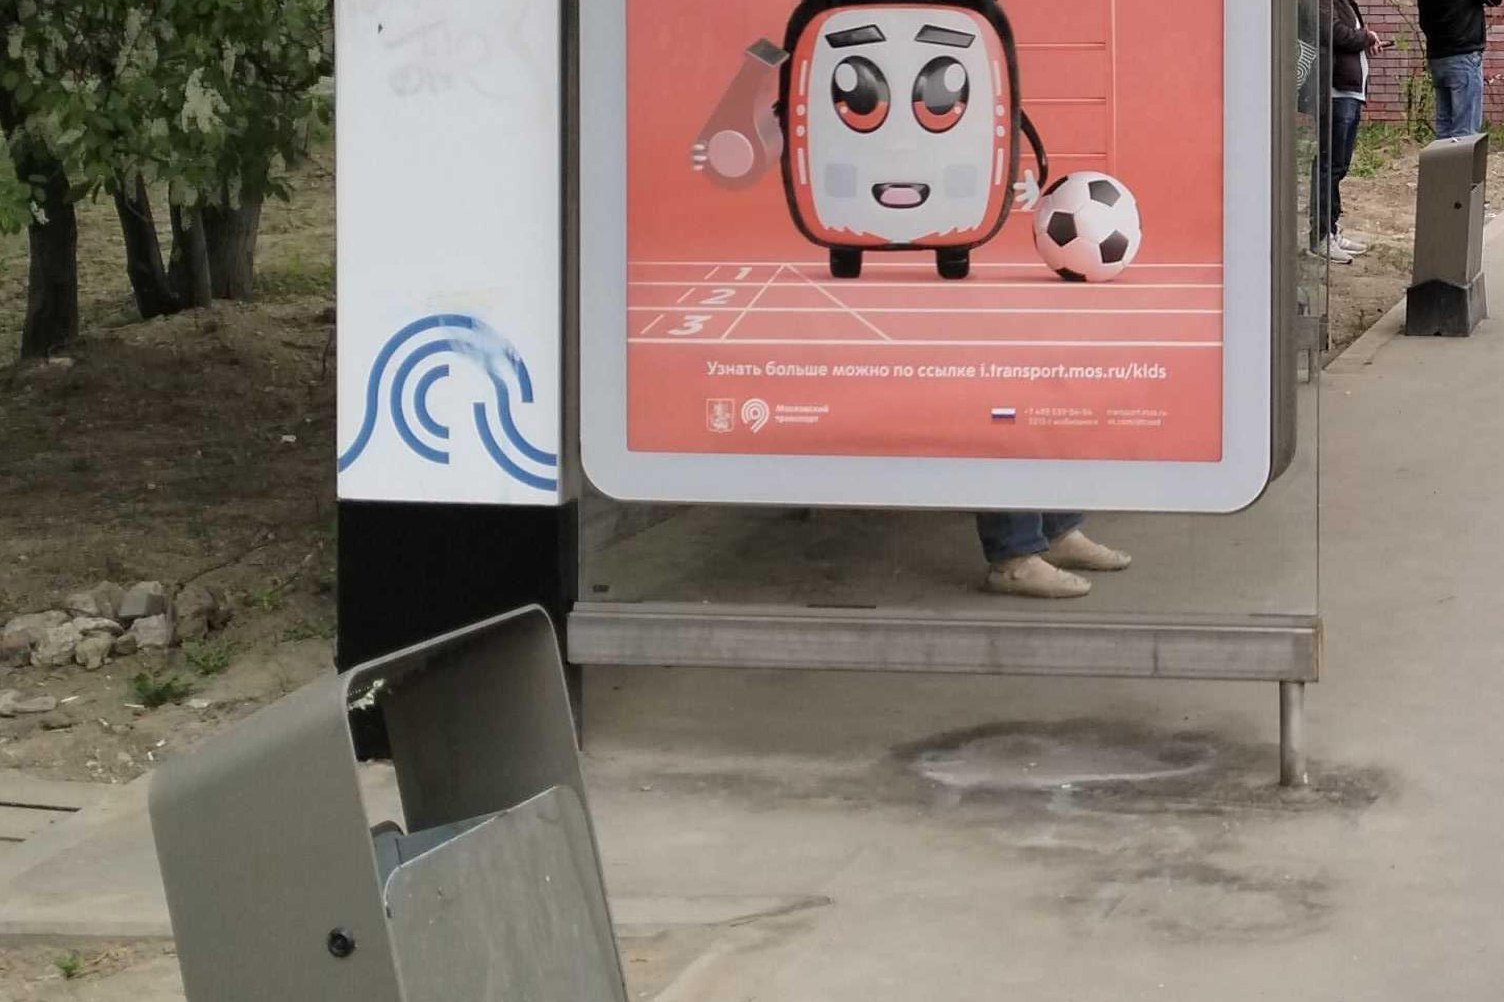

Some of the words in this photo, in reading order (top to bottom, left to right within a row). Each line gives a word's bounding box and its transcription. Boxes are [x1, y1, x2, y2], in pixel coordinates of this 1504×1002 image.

[699, 288, 736, 305] 2
[667, 315, 712, 335] 3
[706, 361, 761, 377] Узнать
[765, 361, 828, 377] больше
[832, 365, 890, 378] можно
[893, 365, 914, 378] по
[917, 365, 976, 379] ссылке
[980, 363, 1167, 381] i.transport.mos.ru/kids
